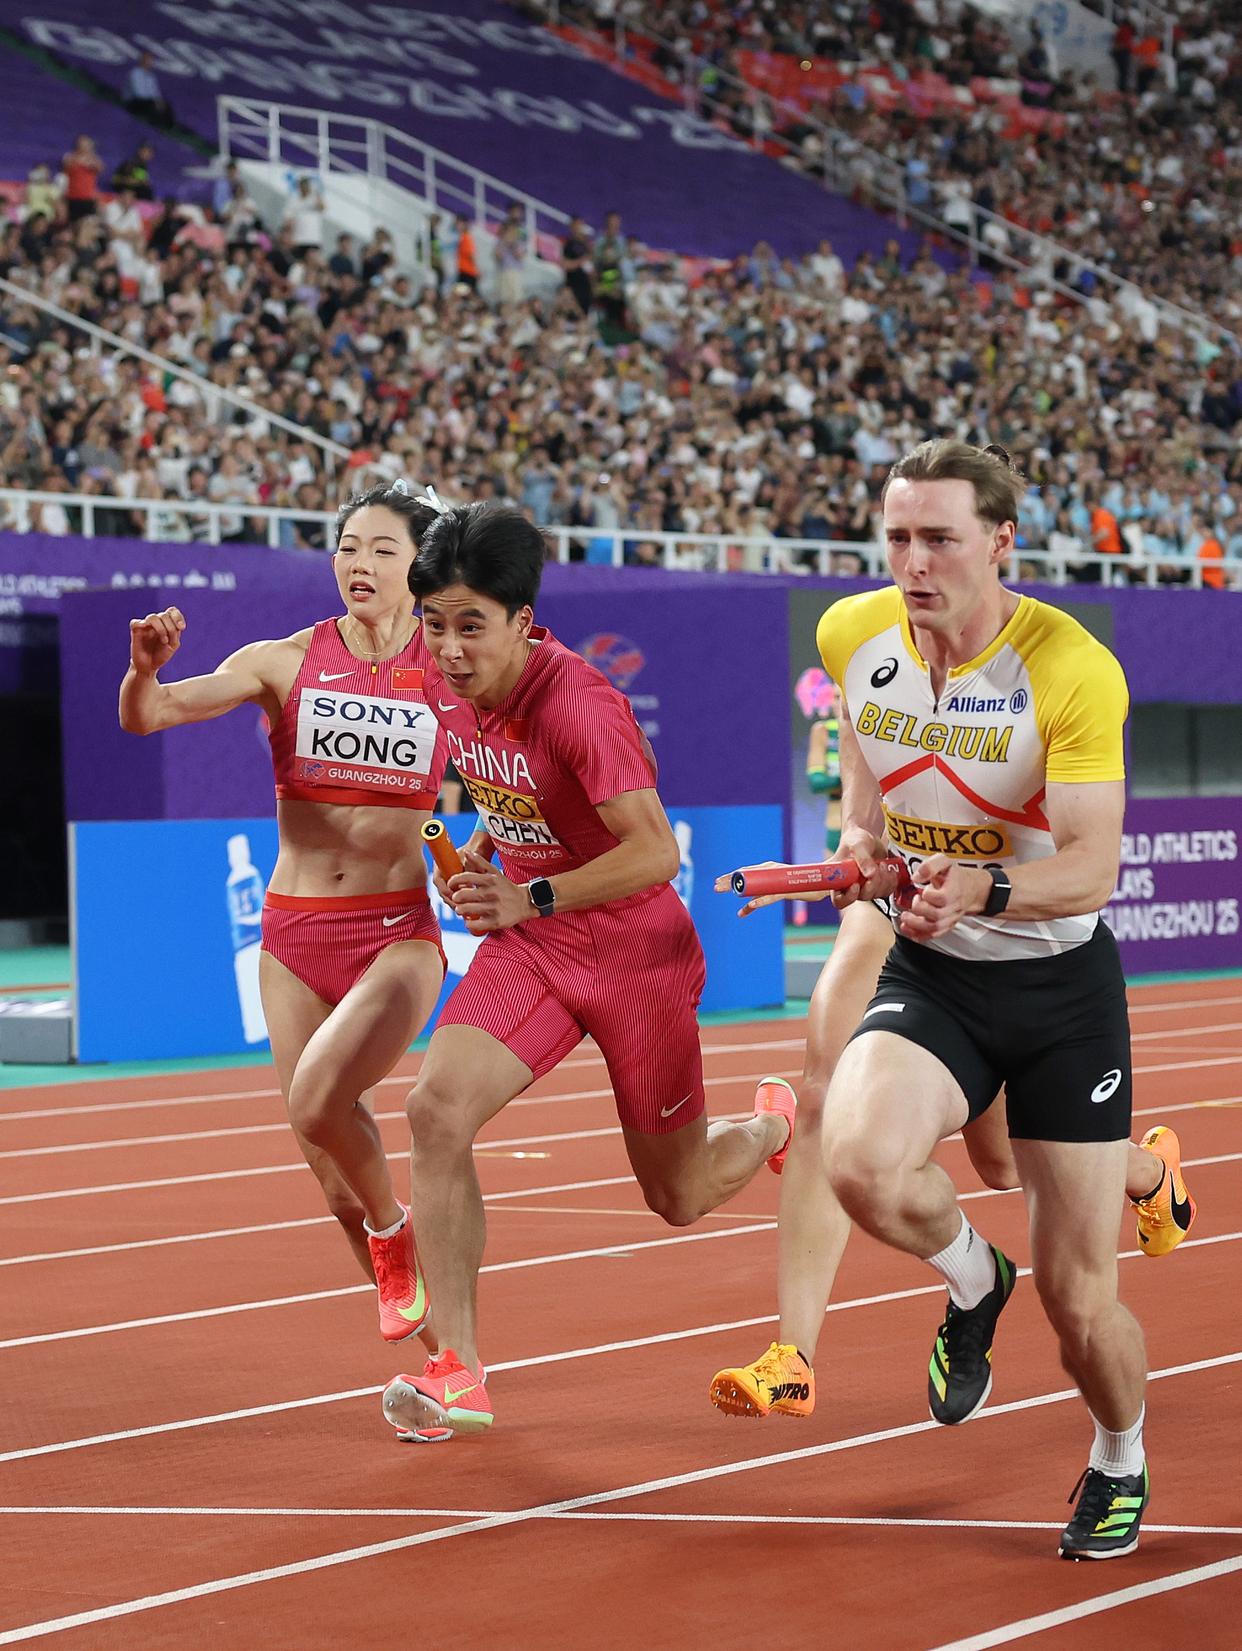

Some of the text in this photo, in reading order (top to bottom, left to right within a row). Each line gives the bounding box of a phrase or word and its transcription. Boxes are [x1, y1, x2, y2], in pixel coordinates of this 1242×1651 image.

[313, 697, 425, 729] SONY
[947, 697, 1006, 713] Allianz
[311, 728, 418, 767] KONG
[856, 701, 1014, 763] BELGIUM
[446, 729, 538, 791] CHINA
[328, 767, 422, 790] GUANGZHOU 25
[465, 778, 536, 818] EIKO
[488, 815, 552, 844] CHEN
[887, 813, 1004, 856] SEIKO
[1152, 830, 1239, 864] ATHLETICS
[1215, 898, 1240, 935] 25
[768, 1383, 810, 1405] NITRO
